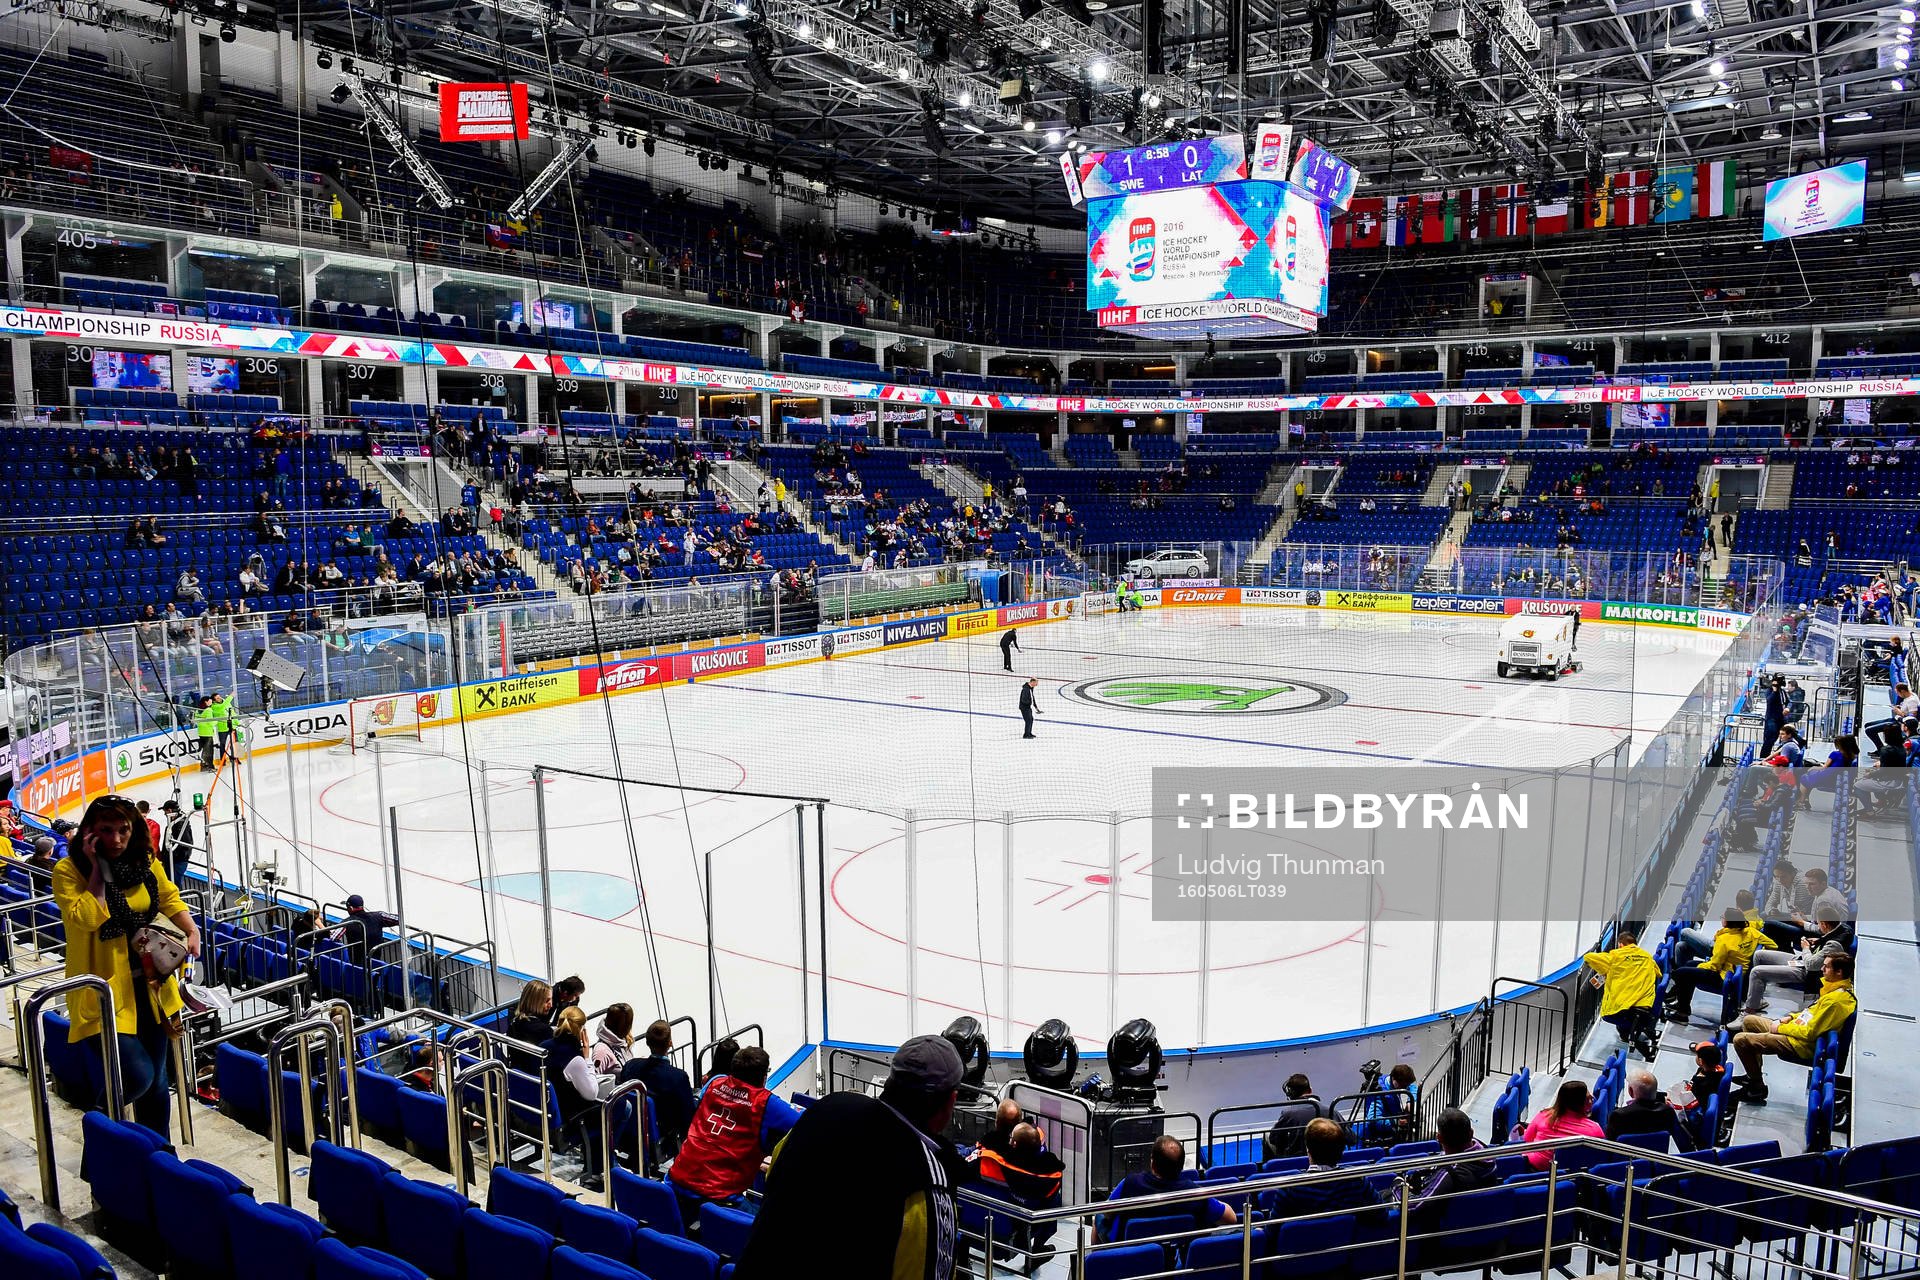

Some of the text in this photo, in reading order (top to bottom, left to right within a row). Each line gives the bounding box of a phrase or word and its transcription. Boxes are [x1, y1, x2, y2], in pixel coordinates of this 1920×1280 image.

[457, 101, 512, 118] МАШИНА
[1146, 148, 1169, 160] 8:58
[1183, 145, 1198, 168] 0
[1123, 155, 1133, 176] 1
[1181, 170, 1203, 183] LAT
[1119, 178, 1145, 191] SWE
[1132, 223, 1153, 235] IIHF
[1163, 221, 1184, 232] 2016
[57, 229, 97, 249] 405
[1163, 235, 1208, 247] ICE HOCKEY
[1162, 245, 1190, 254] WORLD
[1162, 251, 1220, 262] CHAMPIONSHIP
[1102, 309, 1131, 324] IIHF
[1143, 308, 1161, 320] ICE
[1164, 304, 1214, 319] HOCKEY
[1217, 302, 1262, 315] WORLD
[5, 312, 222, 342] CHAMPIONSHIP RUSSIA
[1764, 333, 1790, 344] 412
[1466, 346, 1488, 356] 410
[1572, 341, 1595, 351] 411
[67, 345, 104, 363] 30
[1307, 352, 1327, 363] 409
[245, 357, 278, 374] 306
[348, 365, 376, 380] 307
[480, 373, 505, 388] 308
[556, 379, 579, 393] 309
[618, 365, 640, 377] 2016
[648, 366, 673, 381] IIHF
[697, 371, 733, 385] HOCKEY
[734, 375, 764, 388] WORLD
[764, 378, 821, 391] CHAMPIONSHIP
[823, 383, 848, 393] RUSSIA
[658, 386, 678, 400] 310
[1574, 389, 1598, 400] 2016
[1607, 389, 1636, 402] IIHF
[1667, 386, 1714, 398] HOCKEY
[1716, 384, 1758, 396] WORLD
[1761, 383, 1854, 396] CHAMPIONSHIP
[1859, 380, 1904, 393] RUSSIA
[853, 402, 867, 412] 313
[1060, 400, 1082, 411] IIHF
[1105, 401, 1141, 410] HOCKEY
[1142, 401, 1174, 410] WORLD
[1176, 401, 1244, 409] CHAMPIONSHIP
[1247, 400, 1280, 409] RUSSIA
[1464, 406, 1486, 416] 318
[1568, 404, 1592, 414] 319
[1305, 411, 1324, 420] 317
[1261, 590, 1301, 599] TISSOT
[1352, 600, 1377, 609] БАНК
[1413, 597, 1457, 610] zepter
[1459, 599, 1504, 612] zepter
[956, 613, 988, 631] PIRELLI
[1006, 608, 1038, 623] KRUŠOVICE
[1605, 606, 1698, 624] MAKROFLEX
[1707, 615, 1732, 629] IIHF
[851, 629, 882, 642] TISSOT
[887, 620, 945, 642] NIVEA MEN
[781, 638, 818, 653] TISSOT
[691, 649, 749, 673] KRUŠOVICE
[499, 675, 558, 693] Raiffeisen
[500, 692, 536, 708] BANK
[263, 713, 348, 739] ŠKODA
[139, 737, 202, 766] ŠKOD
